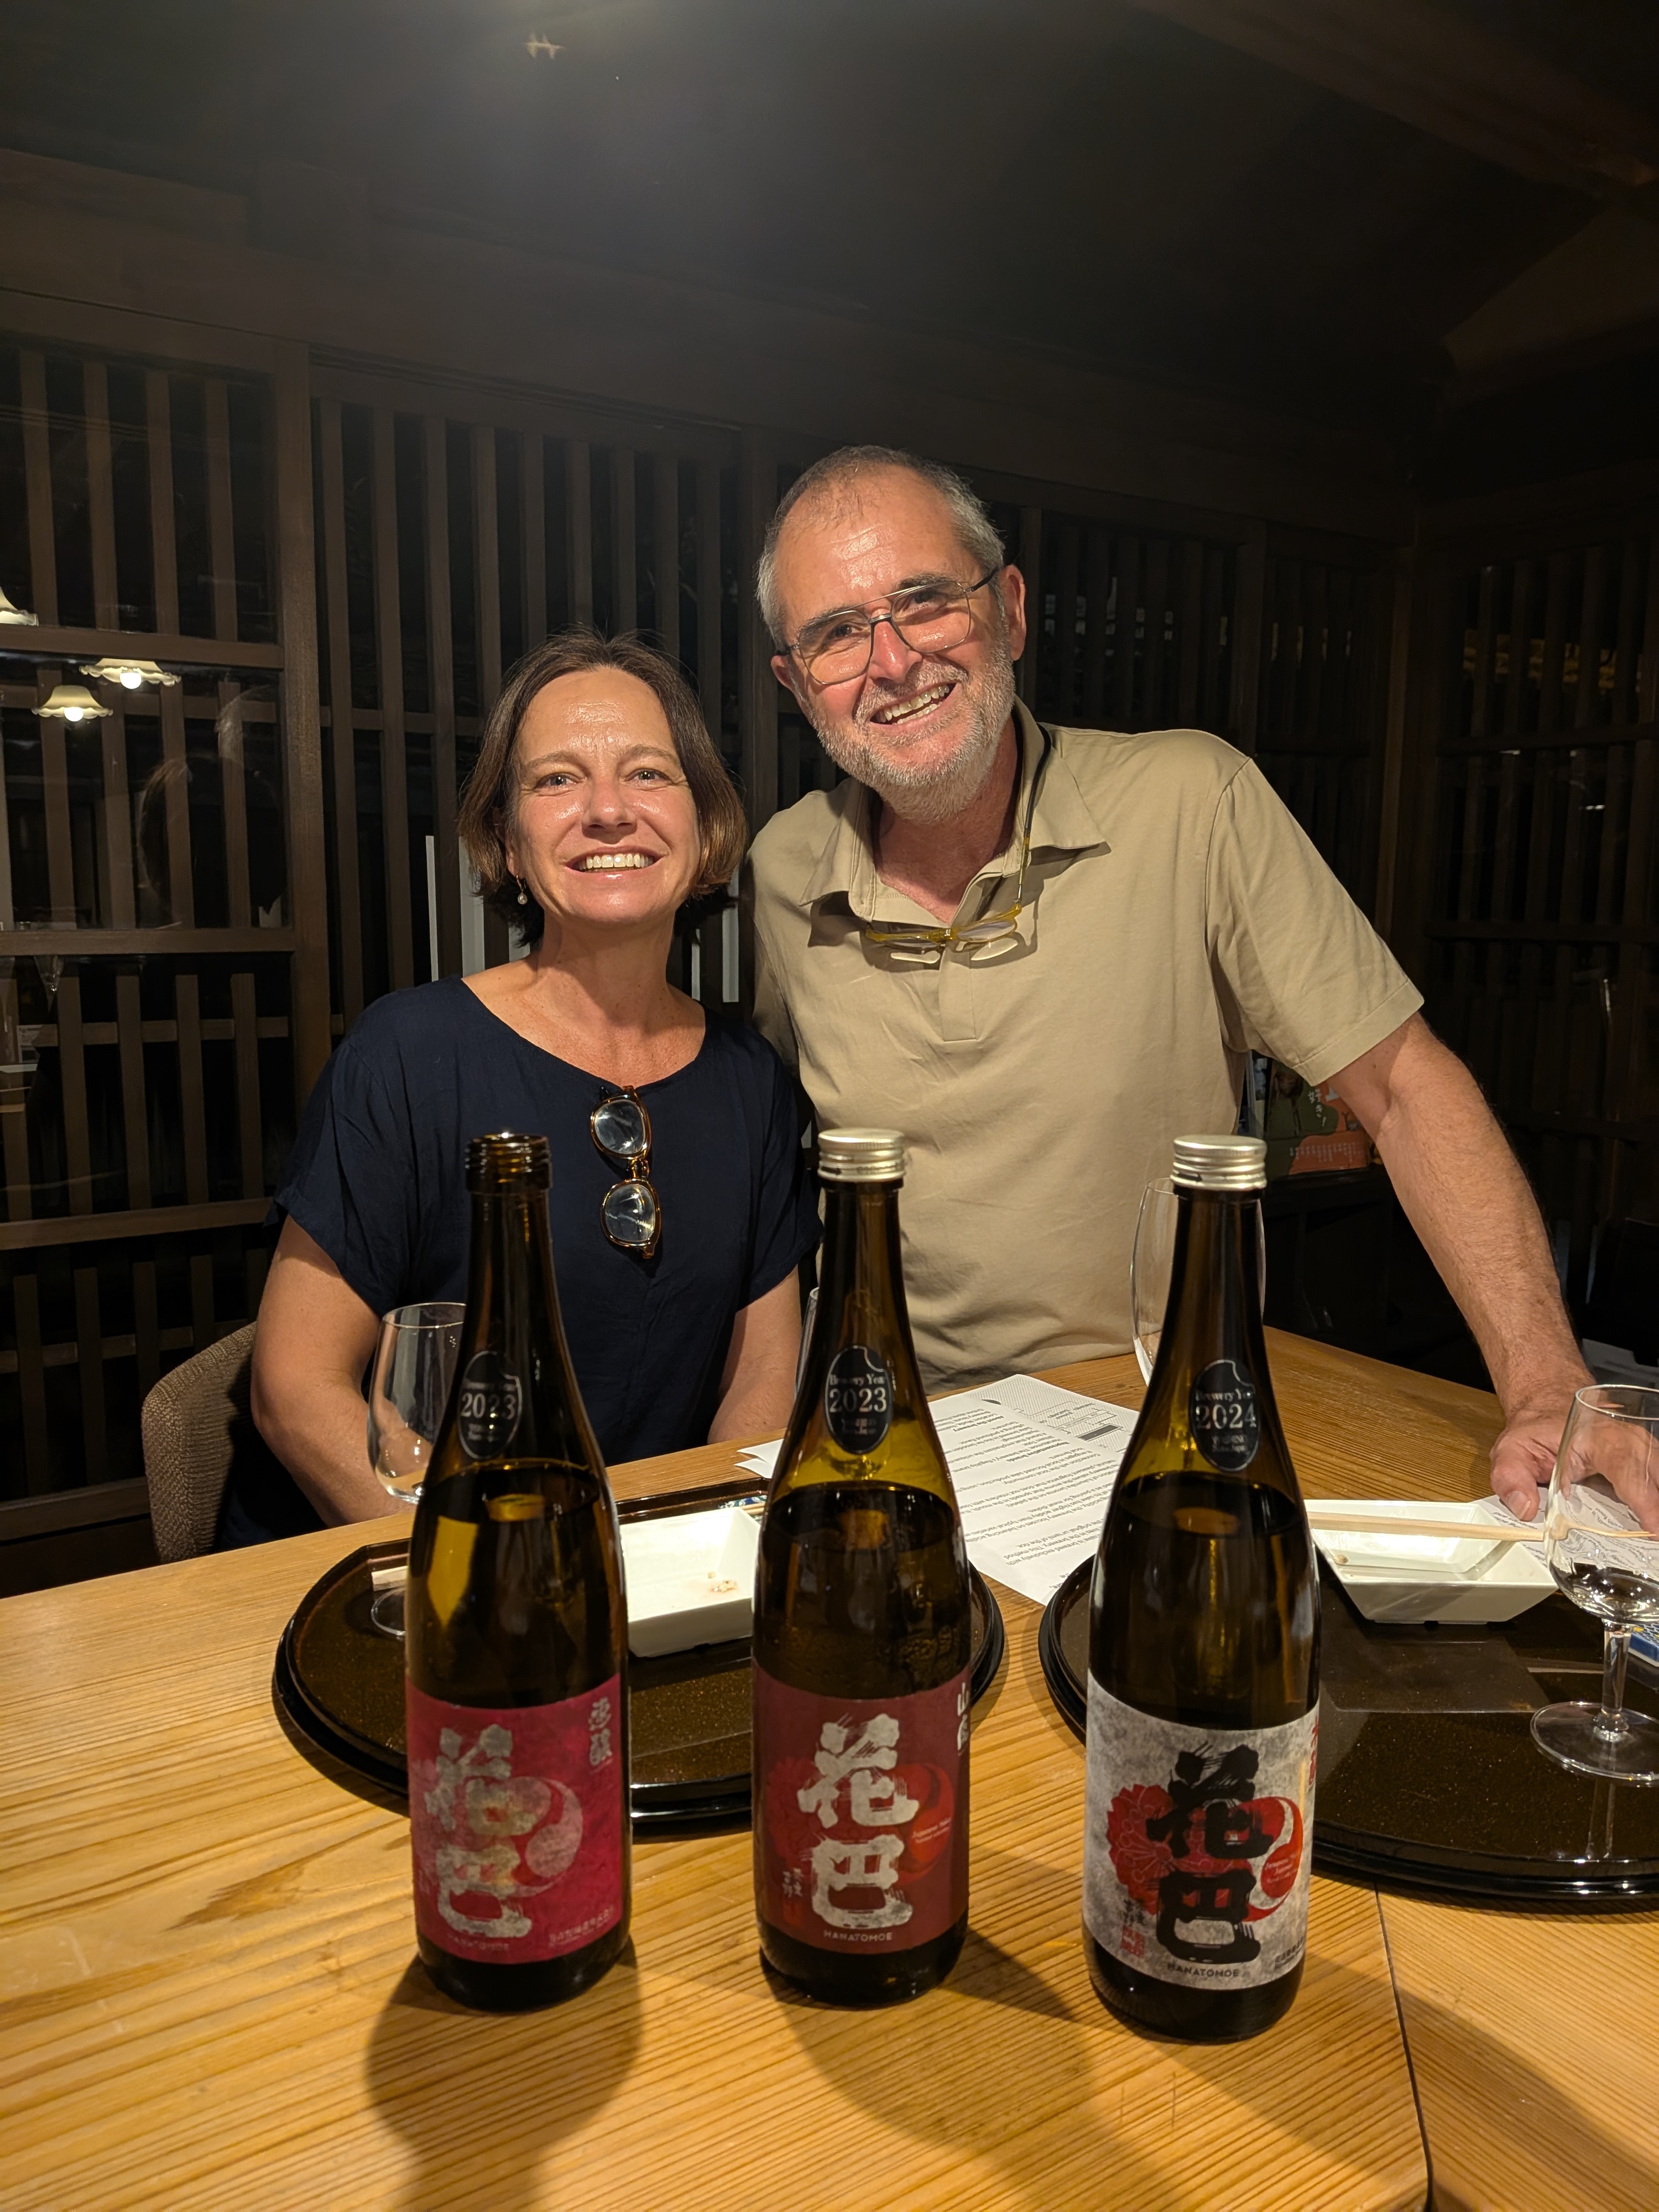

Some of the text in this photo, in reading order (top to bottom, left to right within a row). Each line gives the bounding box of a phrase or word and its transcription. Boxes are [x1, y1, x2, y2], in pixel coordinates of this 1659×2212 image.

[461, 1393, 516, 1420] 2023
[830, 1387, 887, 1413] 2023
[1196, 1404, 1256, 1430] 2024
[953, 1423, 978, 1432] brewery
[1047, 1510, 1073, 1519] brewery
[1004, 1550, 1029, 1559] method
[1054, 1541, 1079, 1551] brewed
[797, 1713, 920, 1929] 花巴
[1146, 1741, 1274, 1963] 花巴
[823, 1928, 894, 1942] HANATOMOE
[1167, 1961, 1239, 1978] HANATOMOE
